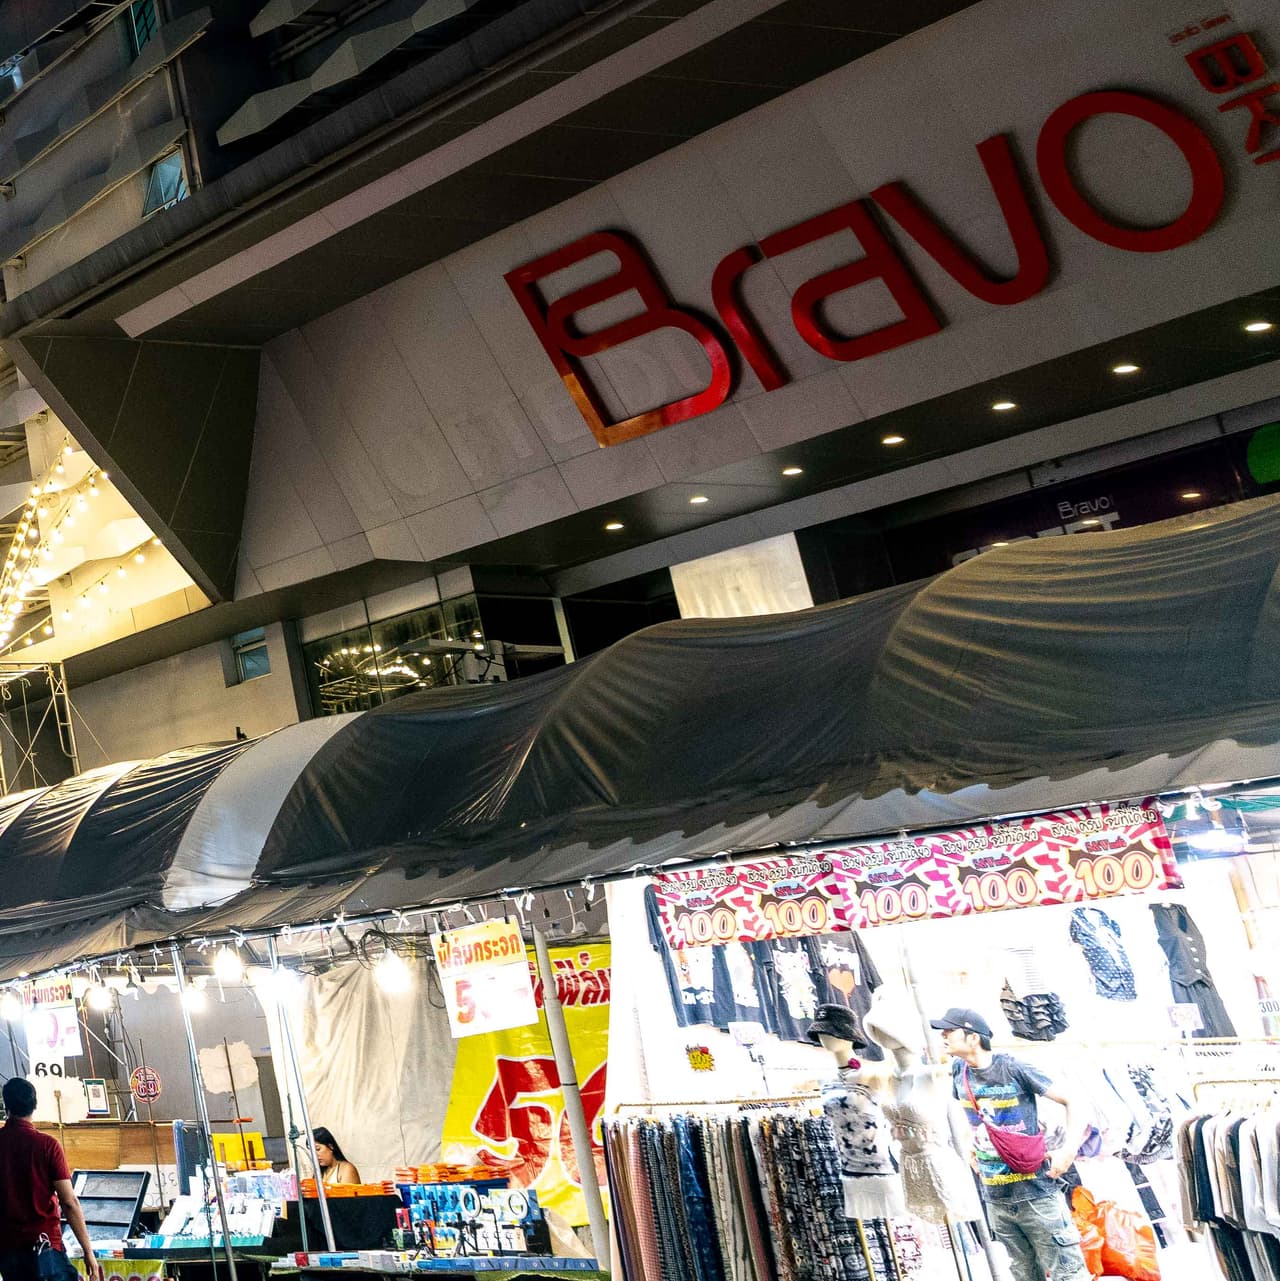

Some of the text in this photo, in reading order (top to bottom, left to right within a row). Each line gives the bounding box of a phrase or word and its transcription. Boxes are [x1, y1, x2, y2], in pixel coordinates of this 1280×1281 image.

[503, 90, 1225, 448] Bravo
[1057, 496, 1111, 520] Bravo
[963, 868, 1037, 911] 100
[1076, 851, 1154, 895] 100
[765, 896, 827, 934] 100
[861, 883, 928, 923] 100
[678, 908, 736, 945] 100
